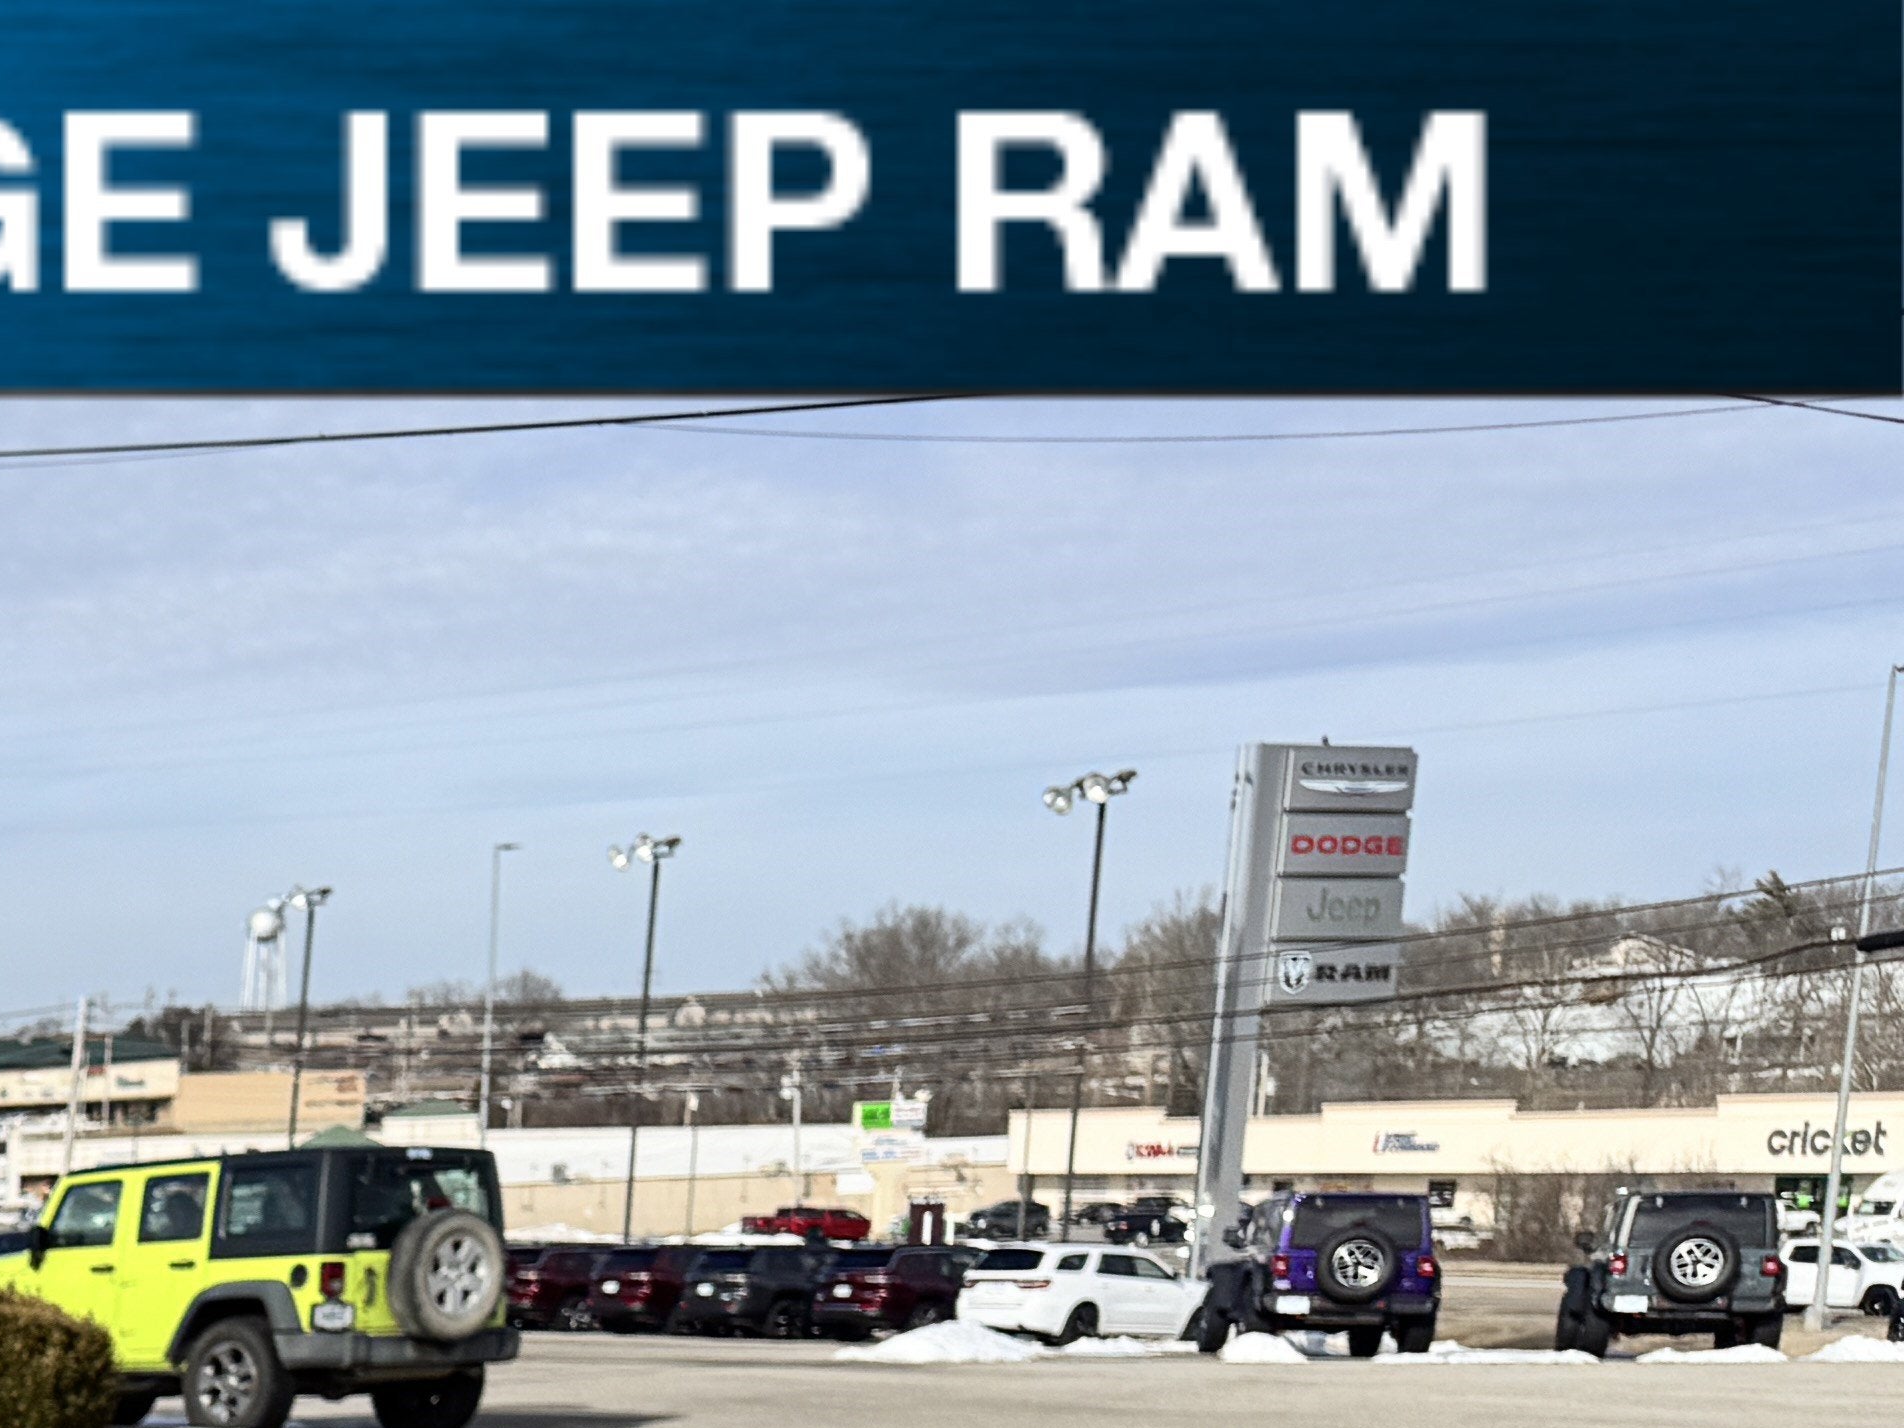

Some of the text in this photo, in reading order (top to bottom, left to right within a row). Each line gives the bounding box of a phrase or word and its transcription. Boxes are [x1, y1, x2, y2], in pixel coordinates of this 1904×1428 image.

[1300, 761, 1409, 777] CHRYSLER
[1290, 834, 1405, 857] DODGE
[1306, 887, 1382, 929] Jeep
[1313, 962, 1391, 984] RAM
